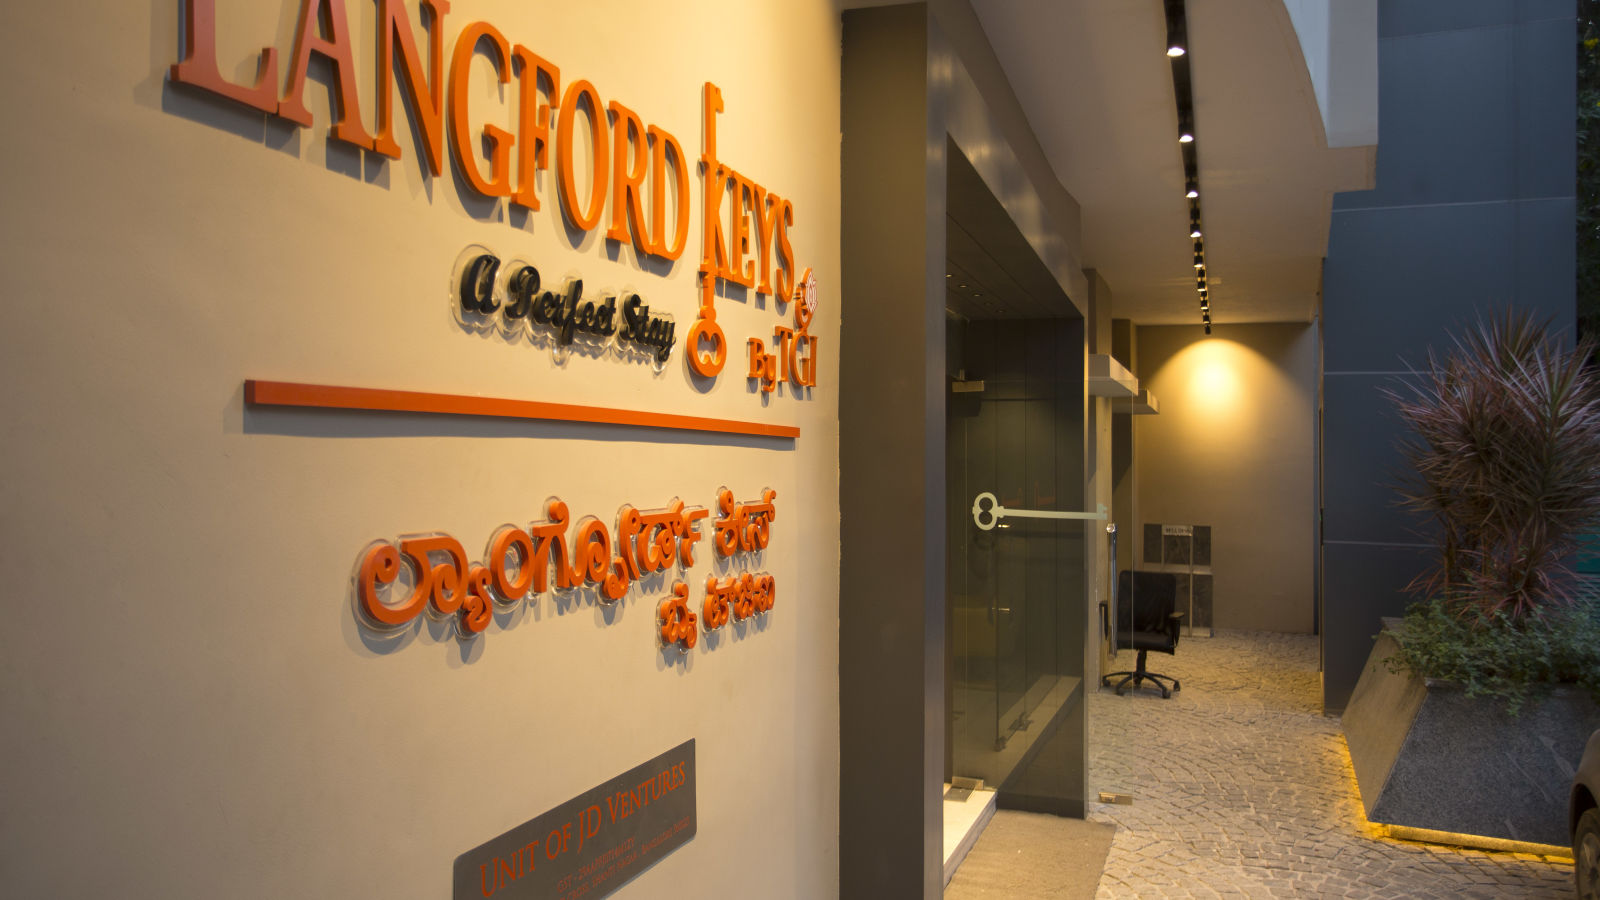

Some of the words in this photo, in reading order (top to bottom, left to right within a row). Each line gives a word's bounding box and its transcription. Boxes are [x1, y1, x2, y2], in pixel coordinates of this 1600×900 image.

[170, 0, 690, 262] LANGFORD
[461, 254, 501, 315] A
[505, 266, 617, 346] Perfect
[619, 294, 677, 362] Stay
[748, 337, 776, 392] By
[775, 325, 818, 388] TGI
[479, 840, 540, 898] UNIT
[545, 822, 572, 860] OF
[577, 804, 602, 854] JD
[606, 760, 686, 824] VENTURES
